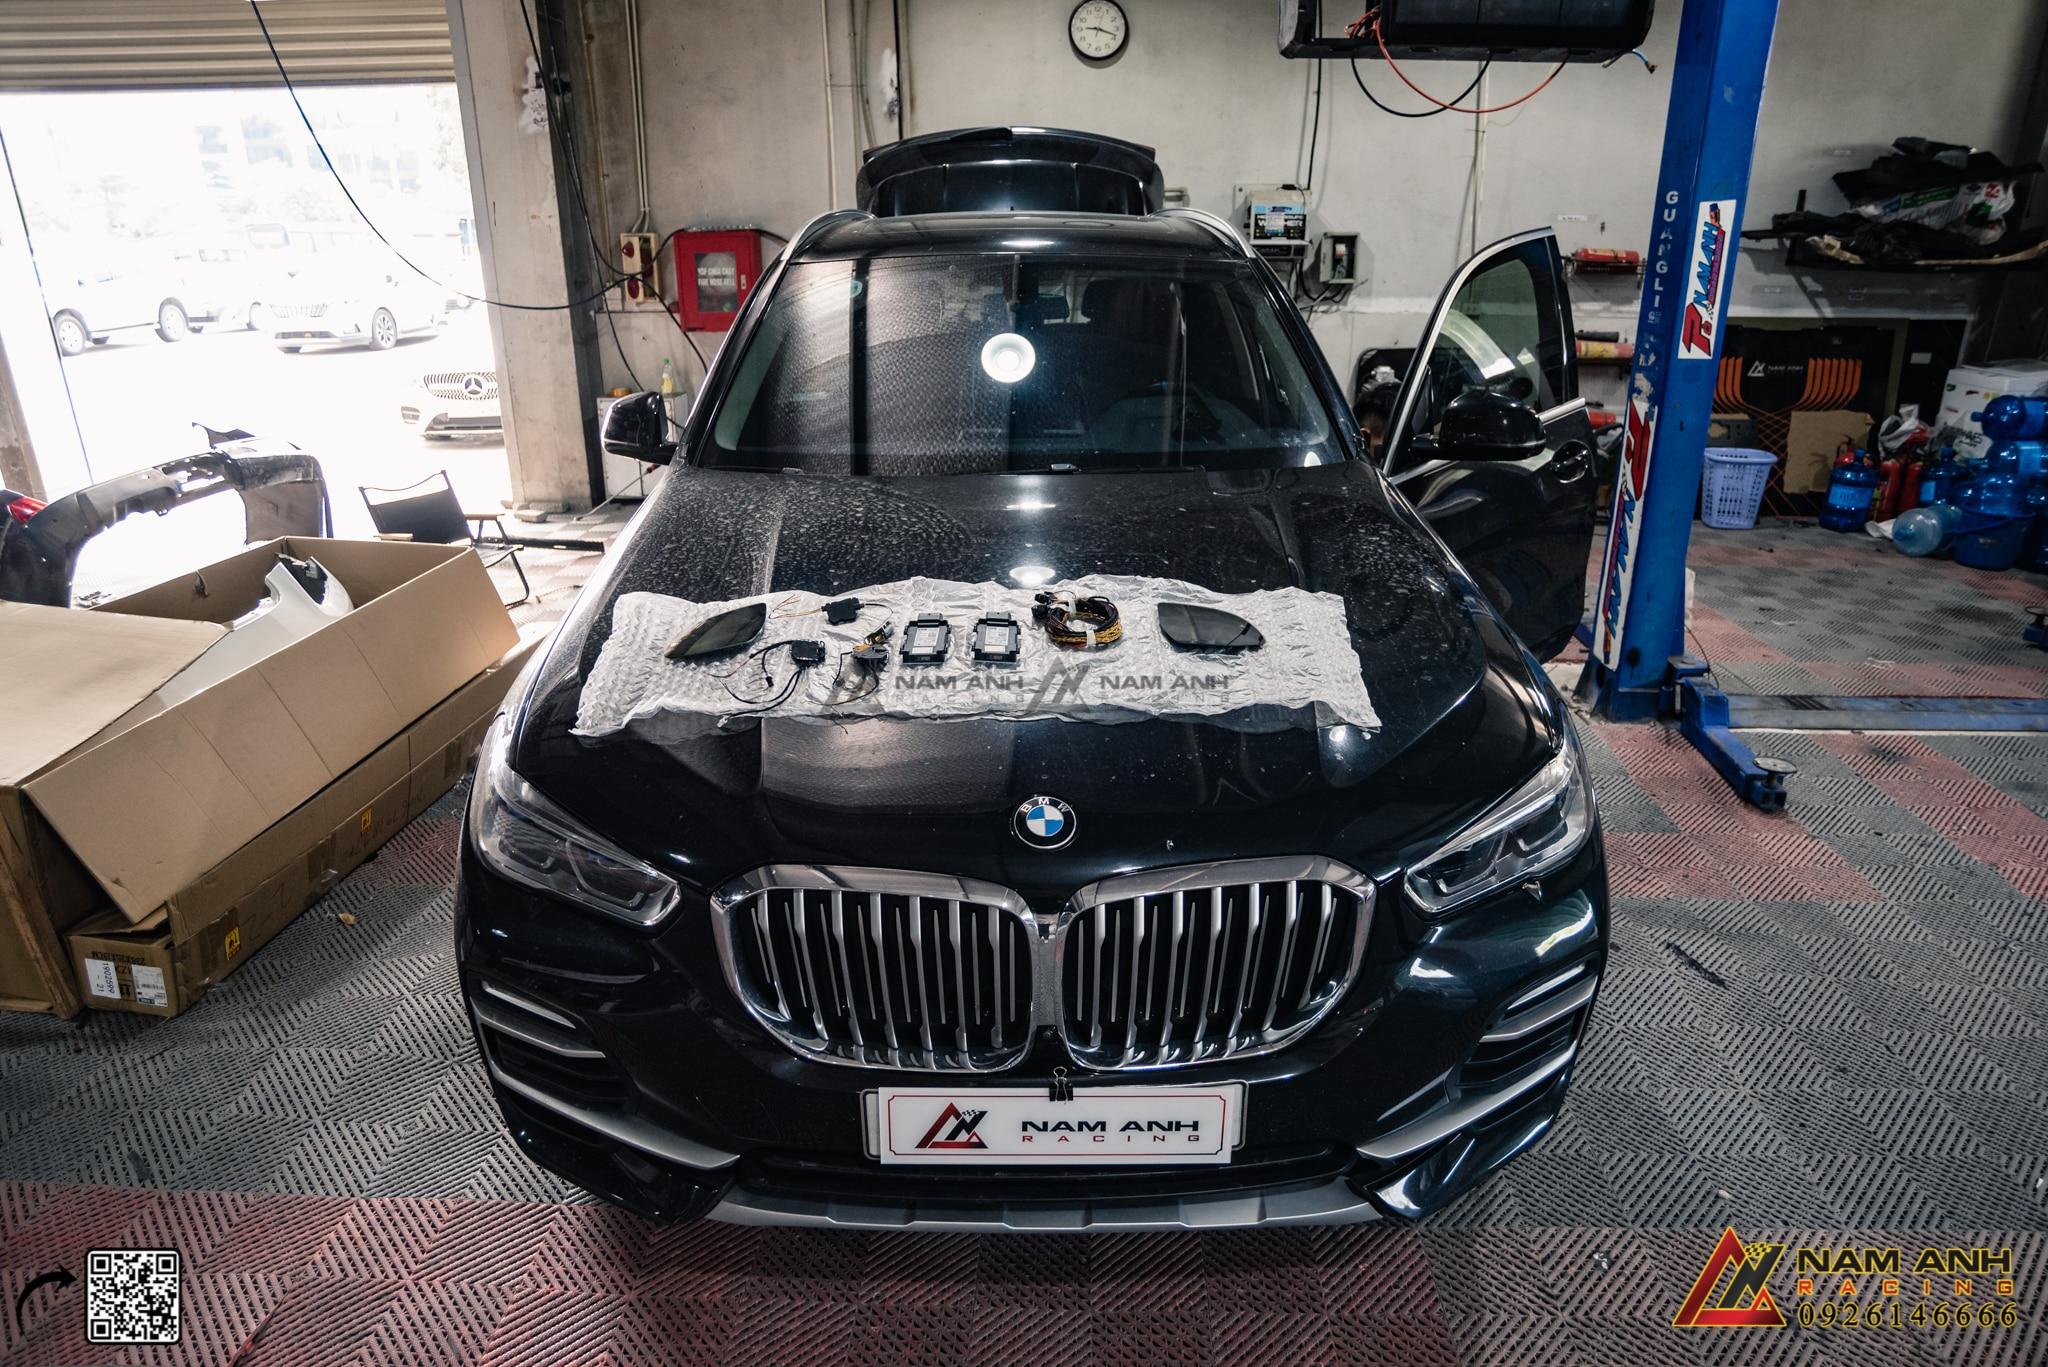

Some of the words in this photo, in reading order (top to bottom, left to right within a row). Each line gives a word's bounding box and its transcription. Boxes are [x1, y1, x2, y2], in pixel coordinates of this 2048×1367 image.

[1020, 797, 1070, 813] BMW
[1021, 1120, 1107, 1132] NAM
[1119, 1120, 1199, 1132] ANH
